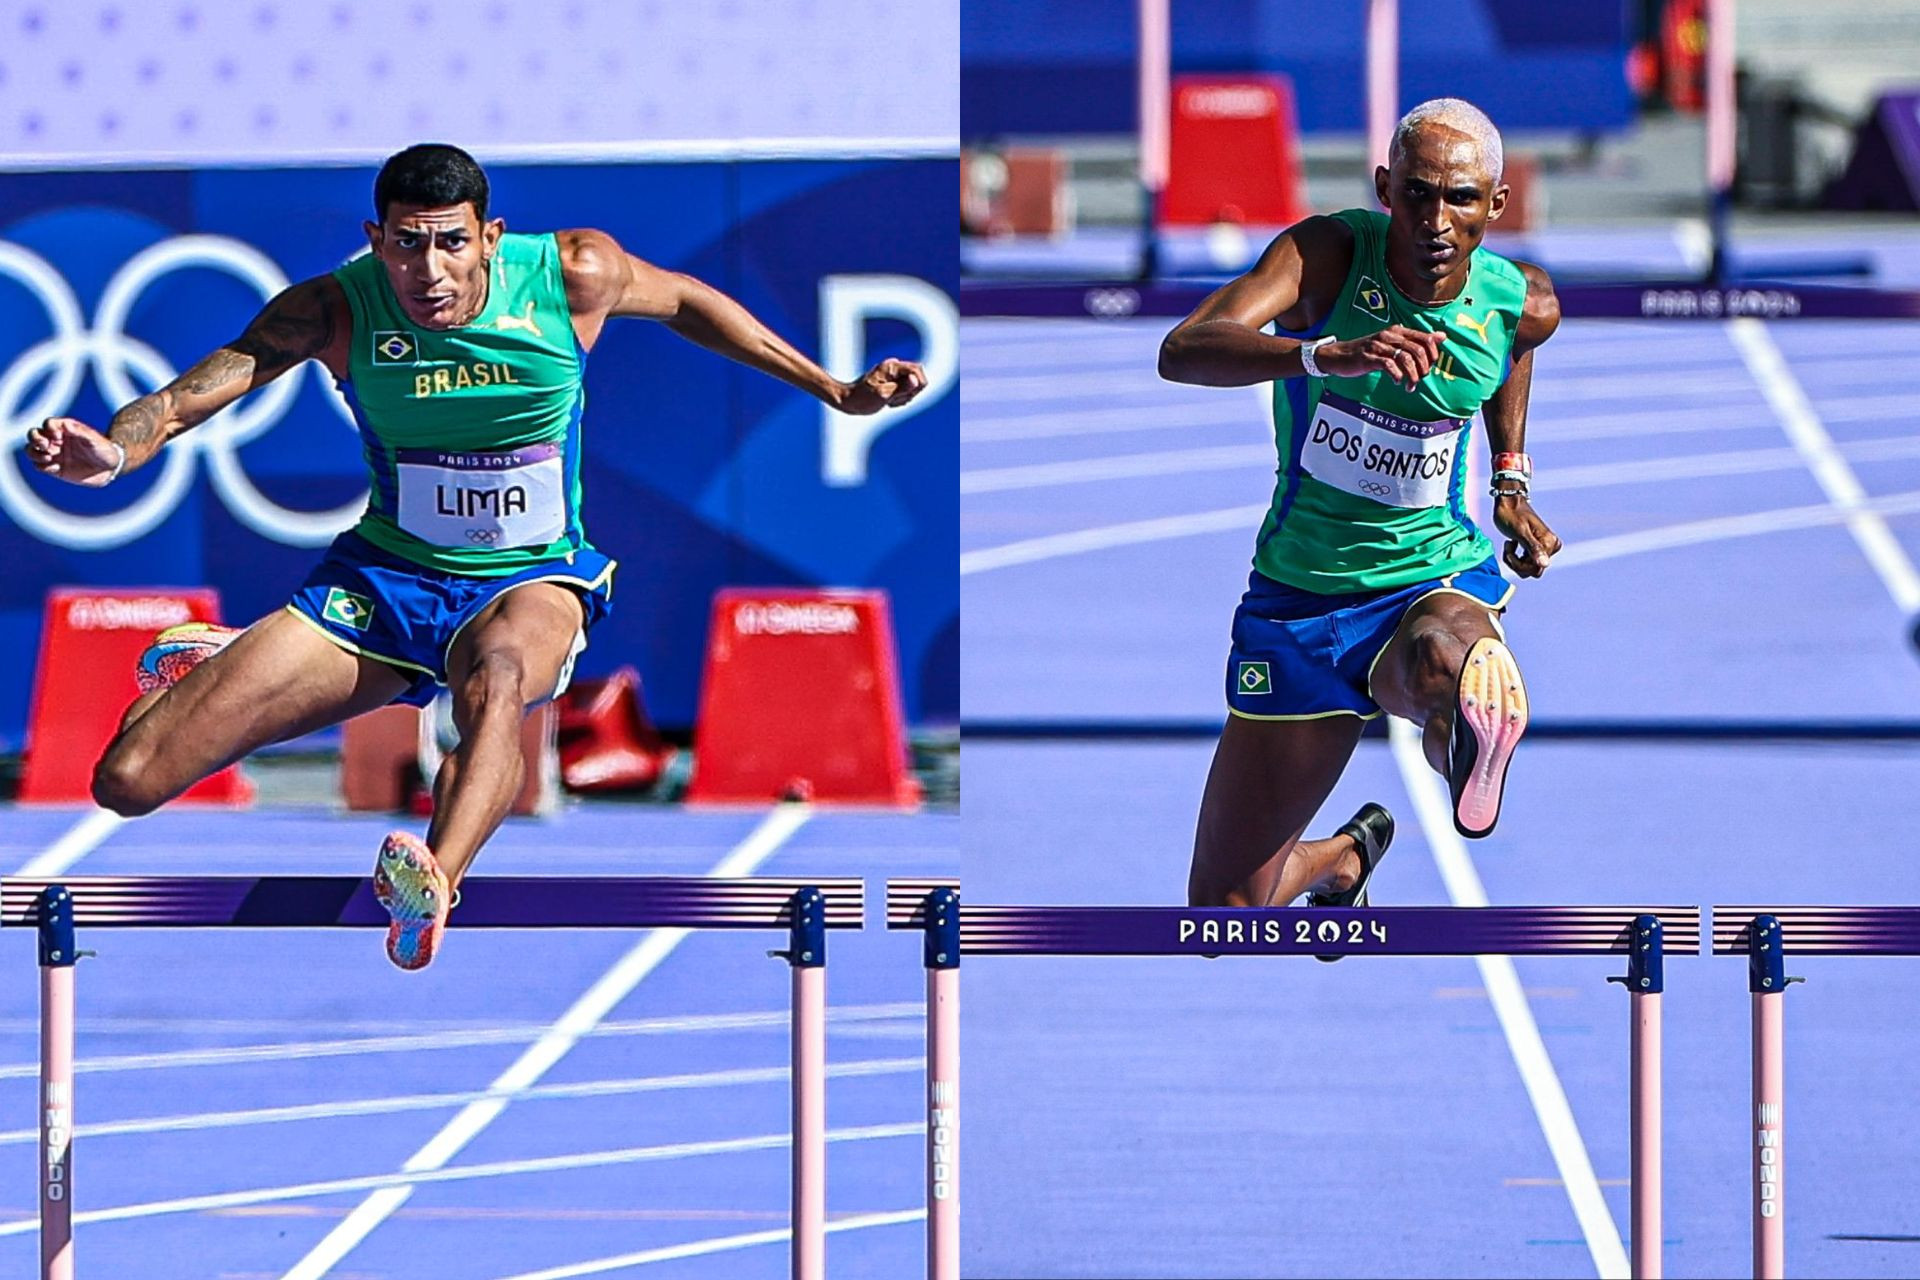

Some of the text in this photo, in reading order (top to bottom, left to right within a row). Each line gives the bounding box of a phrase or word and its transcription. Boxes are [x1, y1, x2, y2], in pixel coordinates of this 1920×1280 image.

[414, 362, 519, 399] BRASIL
[1360, 407, 1435, 434] PARIS 2024
[438, 454, 521, 466] PARIS 2024
[1311, 418, 1449, 480] DOS SANTOS
[436, 484, 526, 518] LIMA
[1179, 919, 1280, 943] PARIS
[46, 1108, 67, 1201] MONDO
[932, 1108, 953, 1200] MONDO
[1758, 1129, 1778, 1218] MONDO
